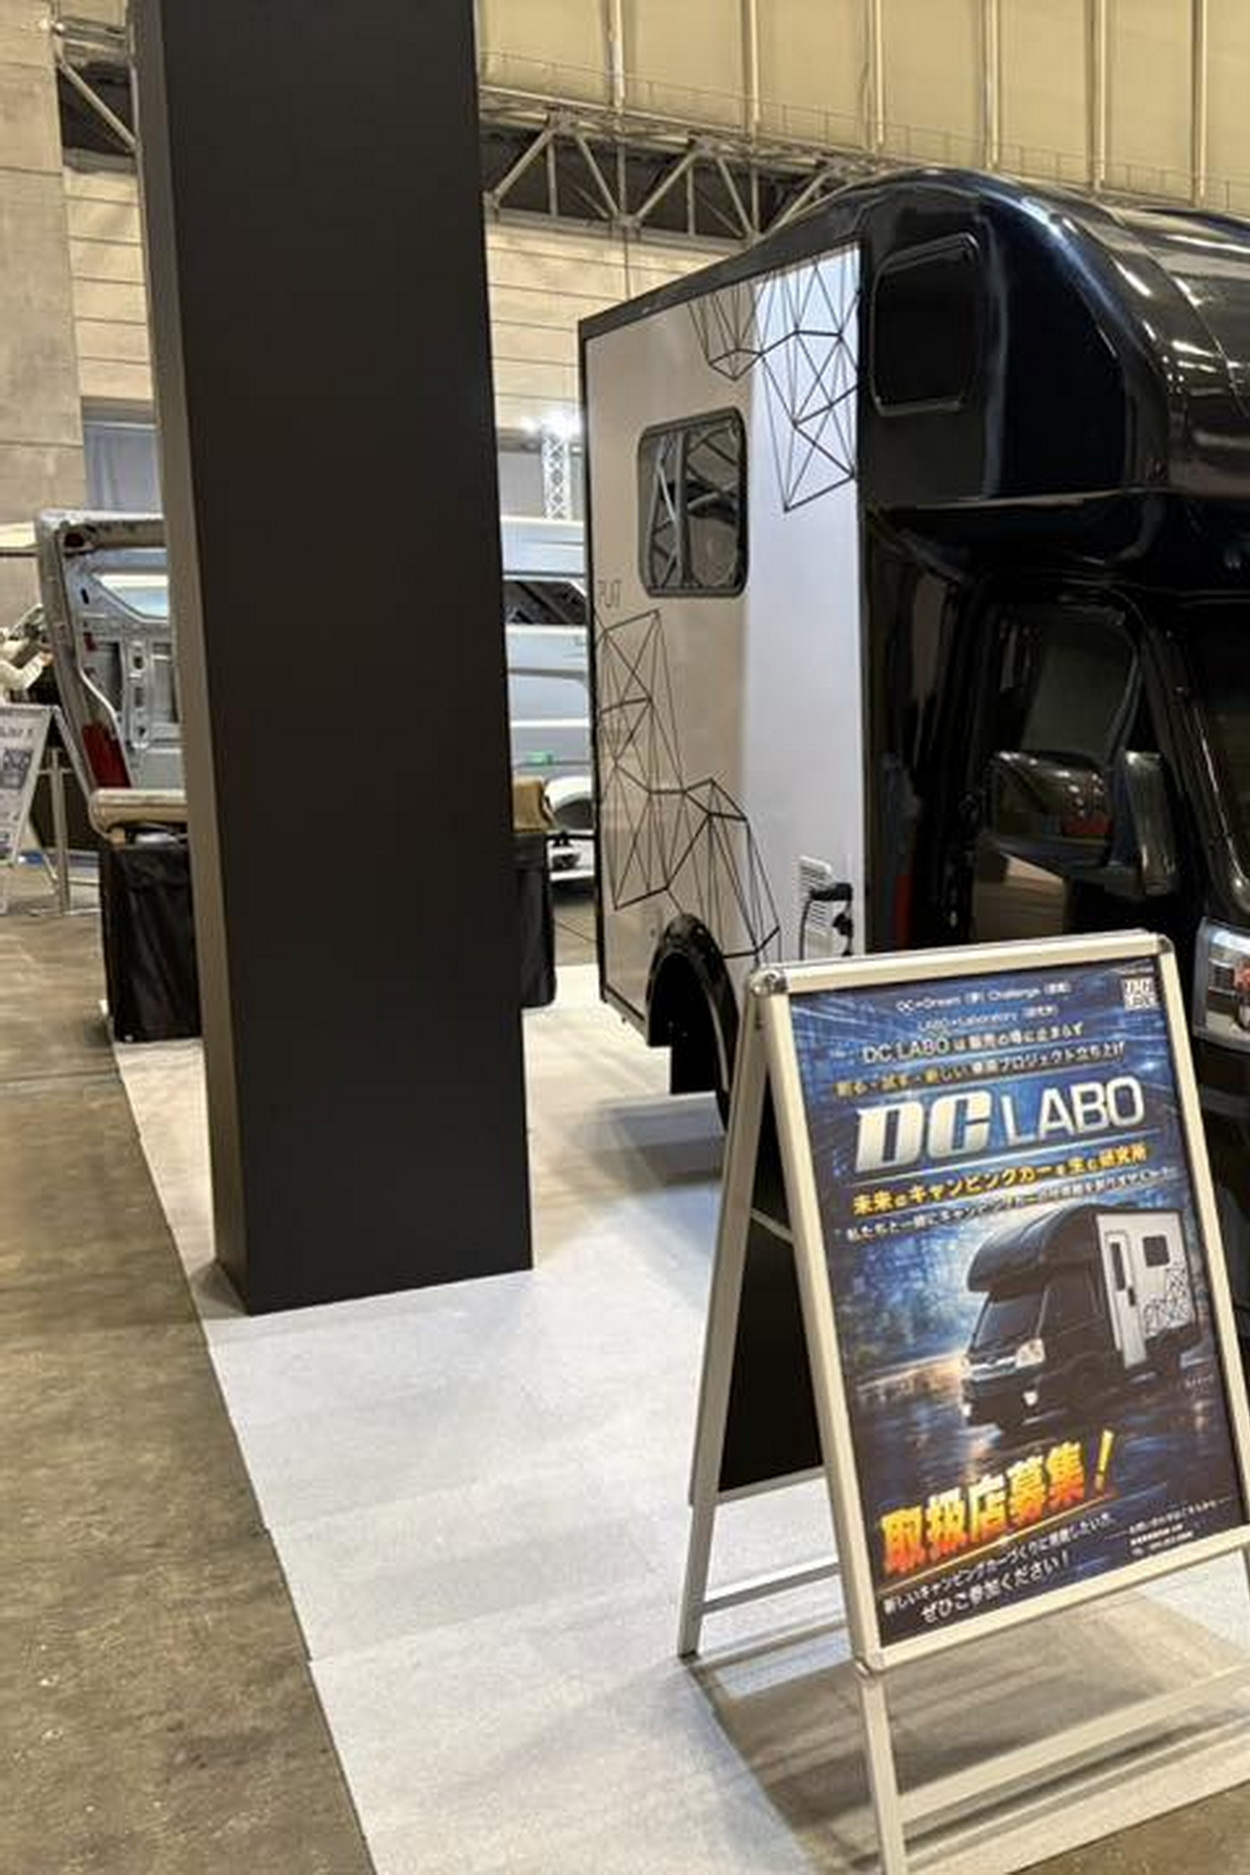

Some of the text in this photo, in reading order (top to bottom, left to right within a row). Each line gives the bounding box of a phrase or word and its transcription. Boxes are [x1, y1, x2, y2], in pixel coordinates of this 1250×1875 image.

[856, 1075, 1144, 1172] DC LABO
[881, 1429, 1116, 1574] 取扱店募集！
